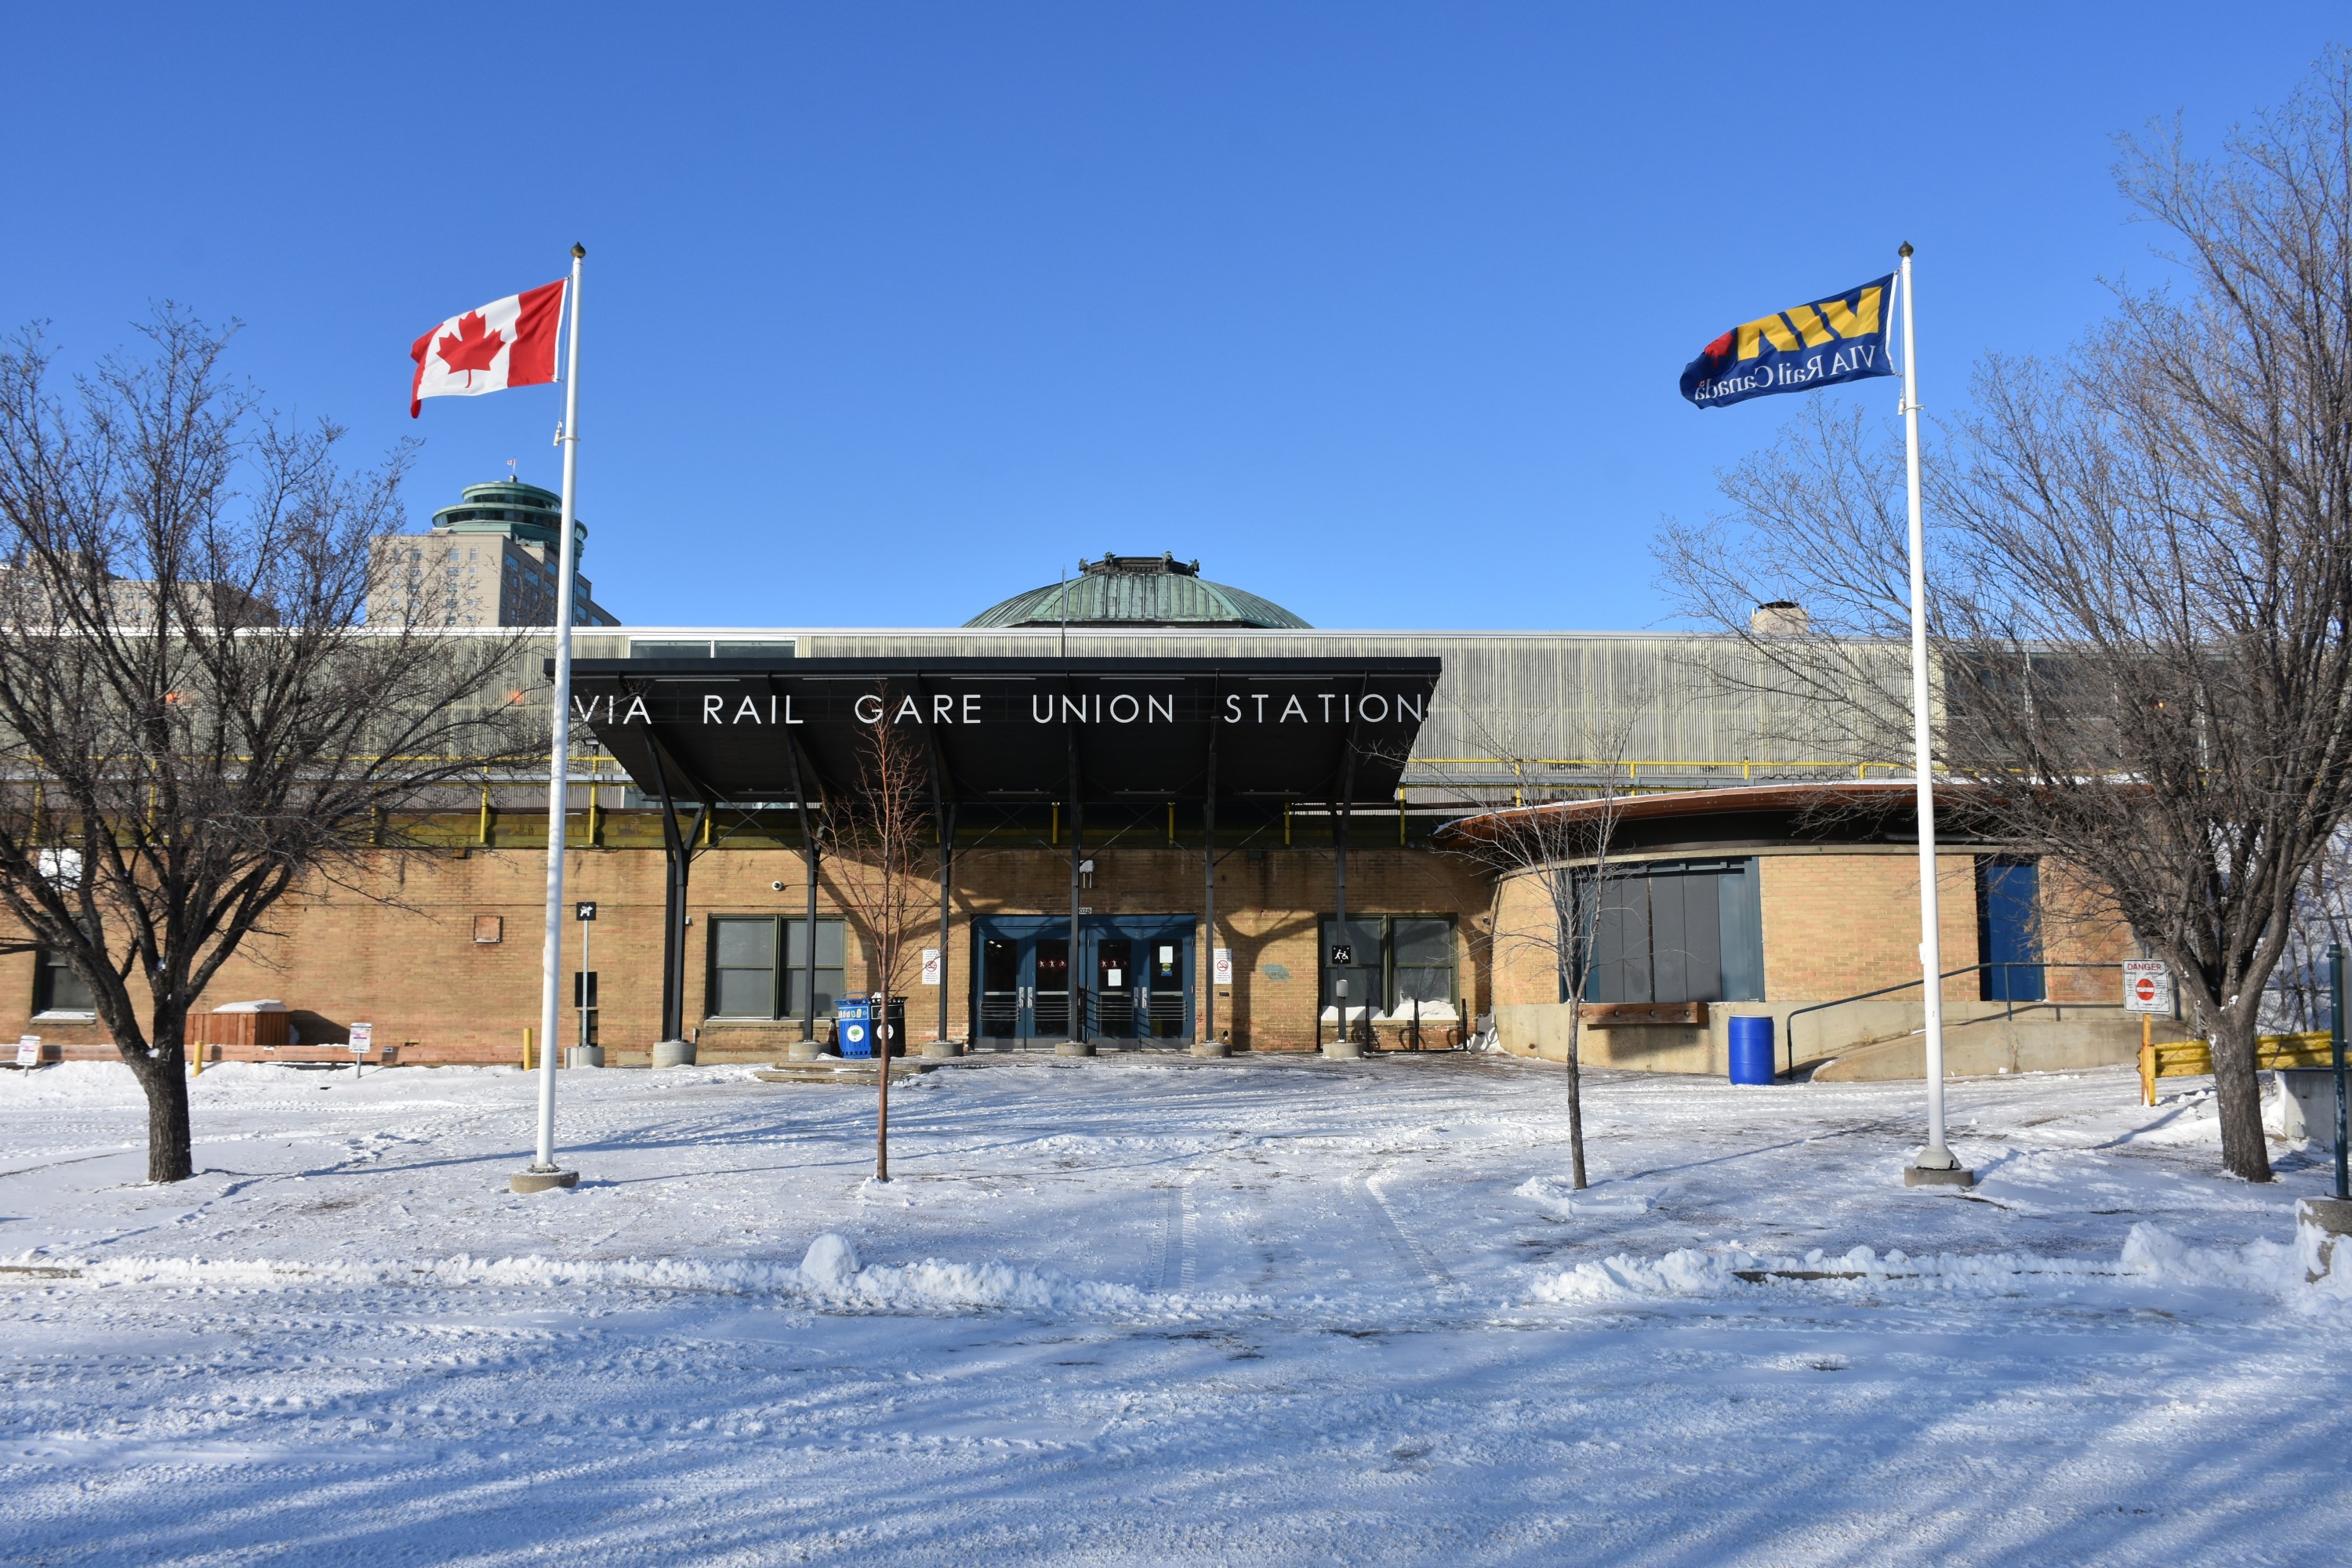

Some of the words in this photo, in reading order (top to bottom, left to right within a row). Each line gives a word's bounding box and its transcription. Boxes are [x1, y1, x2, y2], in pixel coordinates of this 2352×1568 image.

[574, 695, 652, 724] VIA
[703, 695, 804, 724] RAIL
[855, 695, 982, 724] GARE
[1032, 694, 1173, 724] UNION
[1224, 694, 1423, 724] STATION
